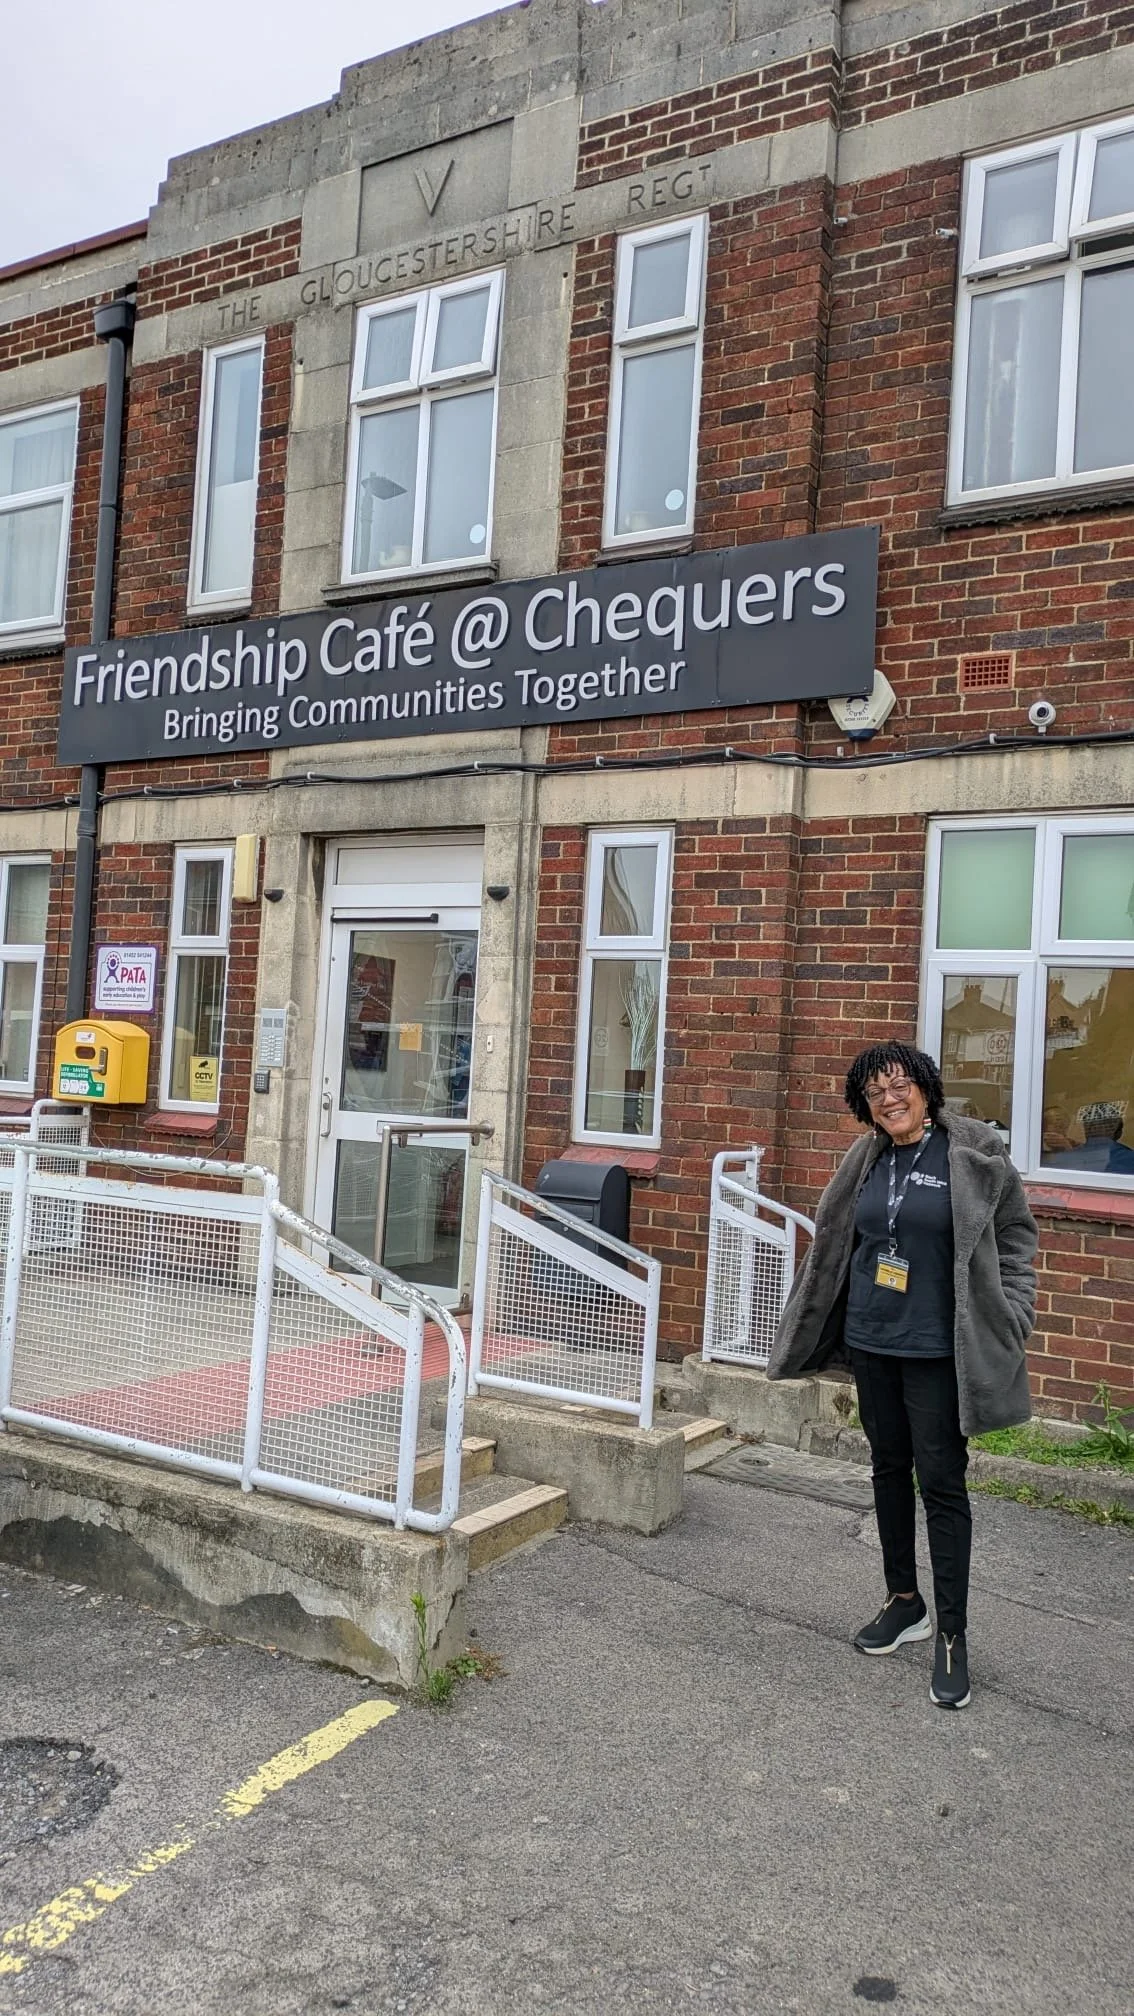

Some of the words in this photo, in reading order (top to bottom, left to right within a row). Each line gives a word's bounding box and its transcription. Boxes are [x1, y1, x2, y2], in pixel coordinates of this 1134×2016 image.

[217, 295, 261, 330] THE
[300, 201, 576, 305] GLOUCESTERSHIRE
[73, 627, 307, 706] Friendship
[320, 602, 435, 677] Café
[451, 596, 509, 669] @
[525, 563, 846, 651] Chequers
[164, 704, 280, 742] Bringing
[289, 677, 504, 729] Communities
[515, 656, 686, 711] Together
[120, 966, 146, 984] PATA
[195, 1072, 213, 1080] CCTV
